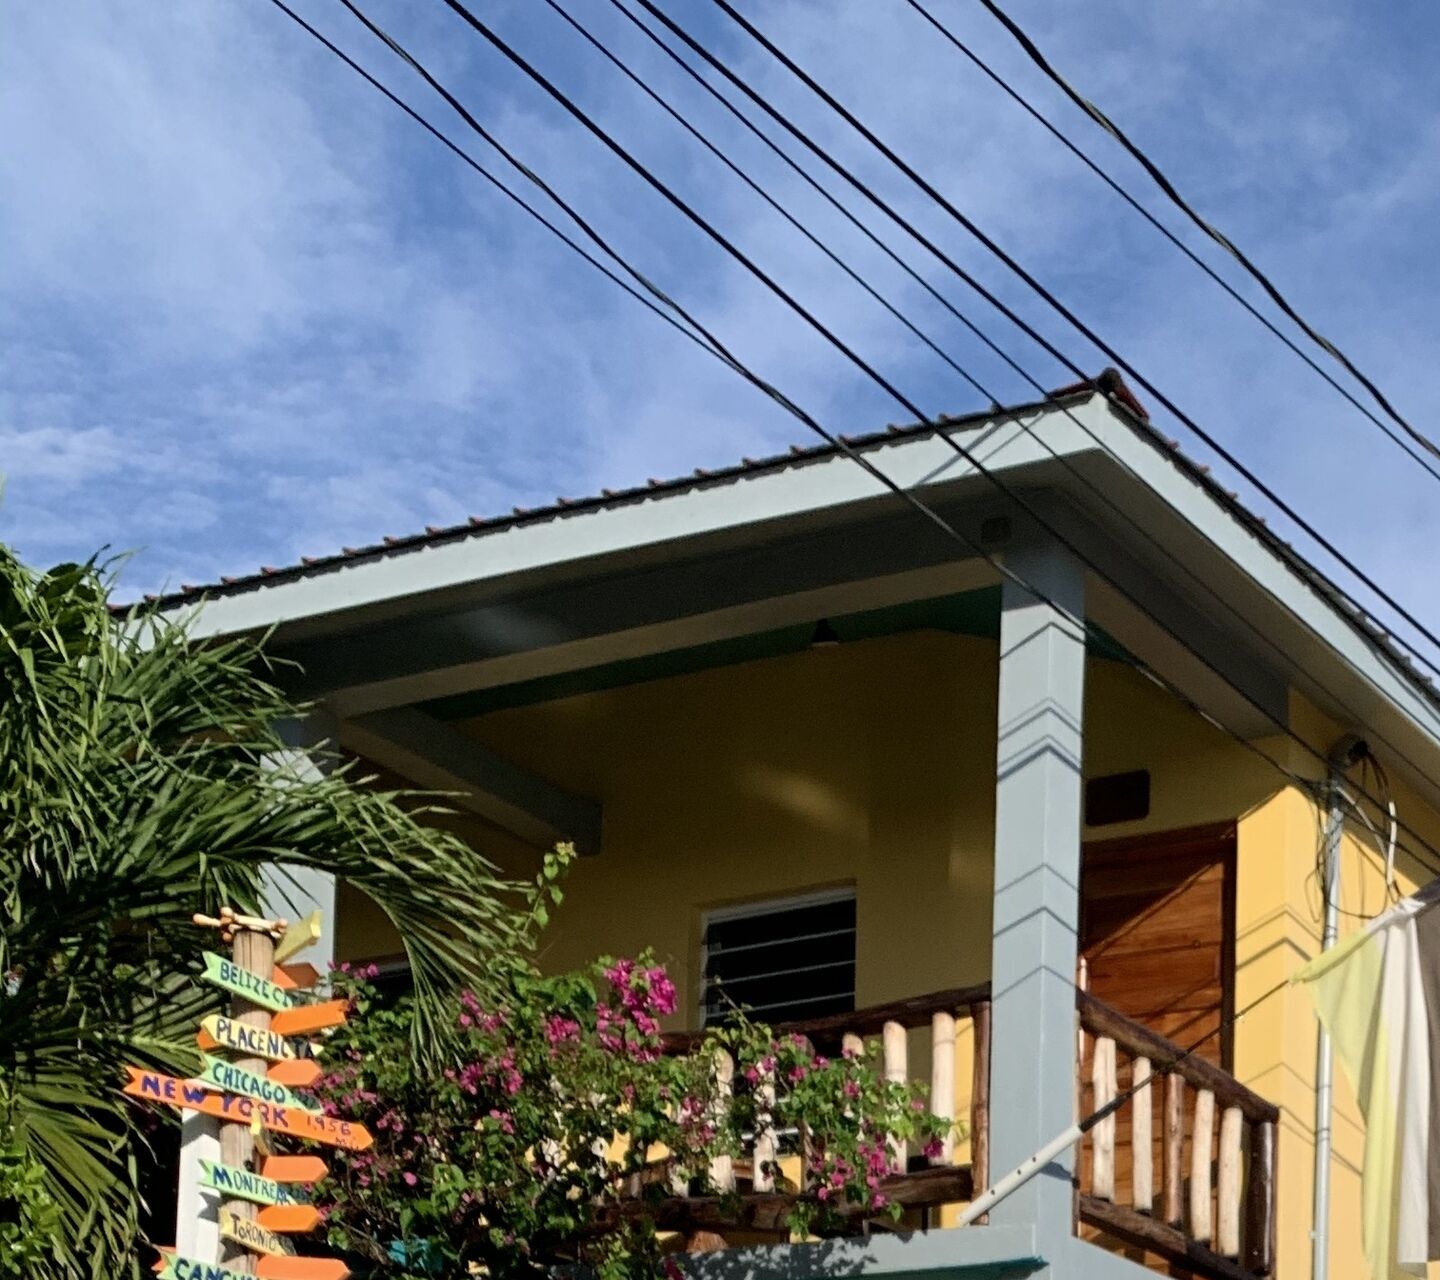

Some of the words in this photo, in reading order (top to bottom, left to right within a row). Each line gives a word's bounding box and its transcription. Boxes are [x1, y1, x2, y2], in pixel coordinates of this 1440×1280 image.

[220, 962, 270, 999] BELIZE
[141, 1075, 207, 1103] NEW
[221, 1092, 289, 1128] YORK
[213, 1062, 286, 1104] CHICAGO
[213, 1165, 290, 1205] MONTREAL
